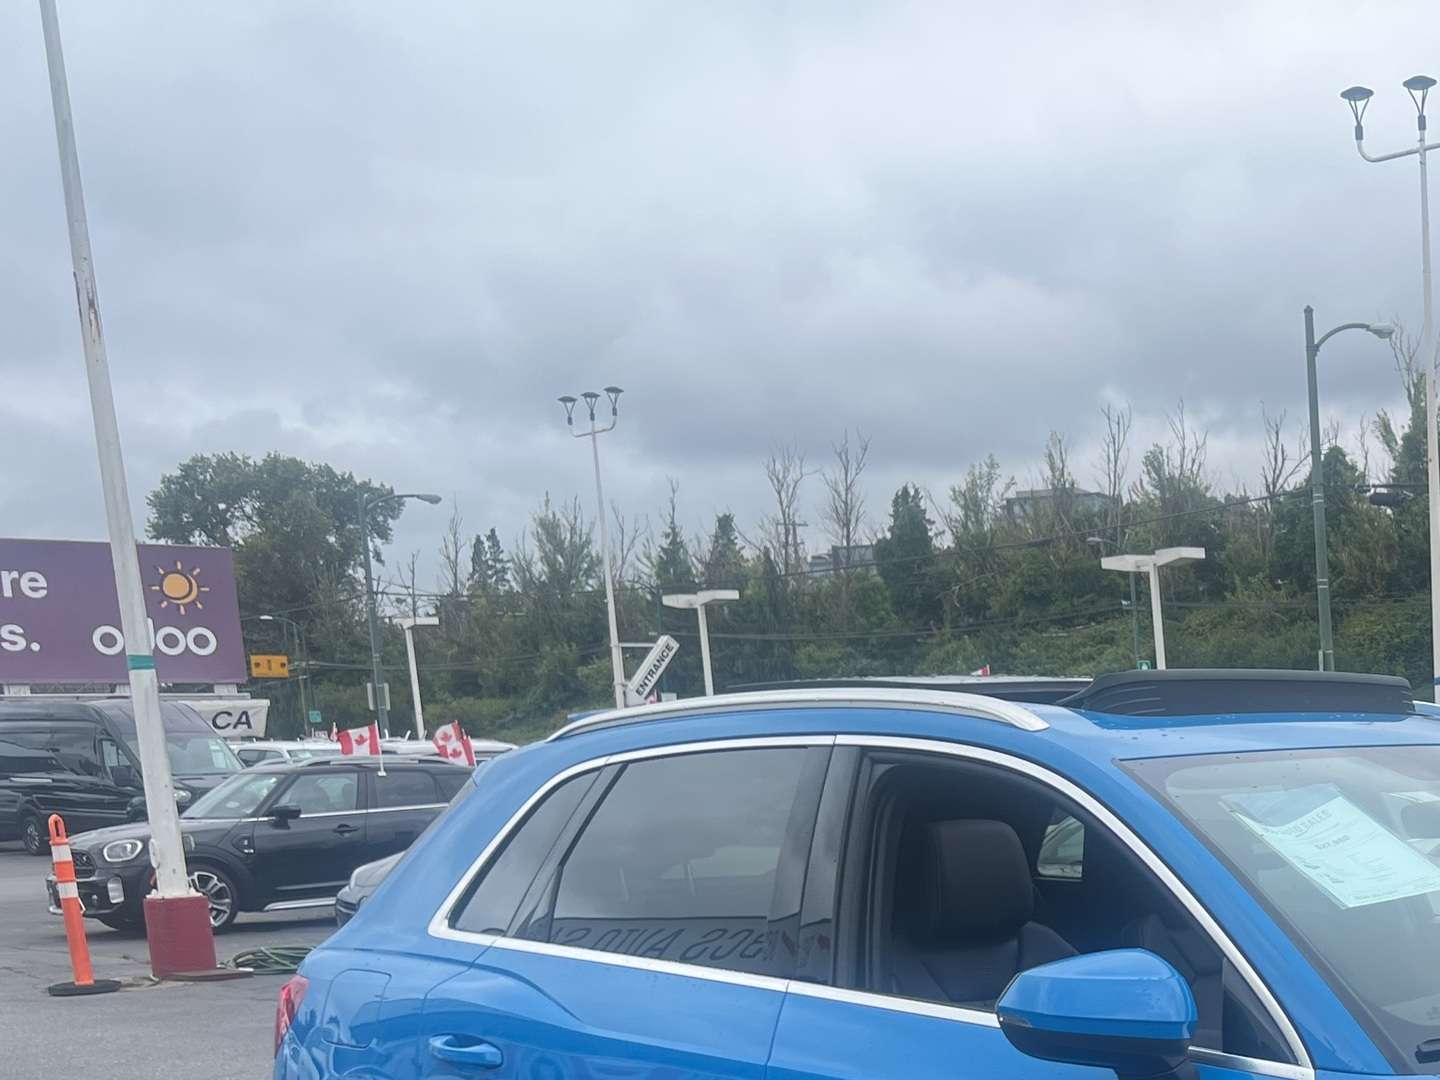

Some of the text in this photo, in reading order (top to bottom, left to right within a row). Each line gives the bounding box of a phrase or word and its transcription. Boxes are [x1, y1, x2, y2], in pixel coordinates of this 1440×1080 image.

[92, 617, 217, 656] ooo
[635, 642, 674, 697] ENTRANCE
[211, 711, 253, 730] CA
